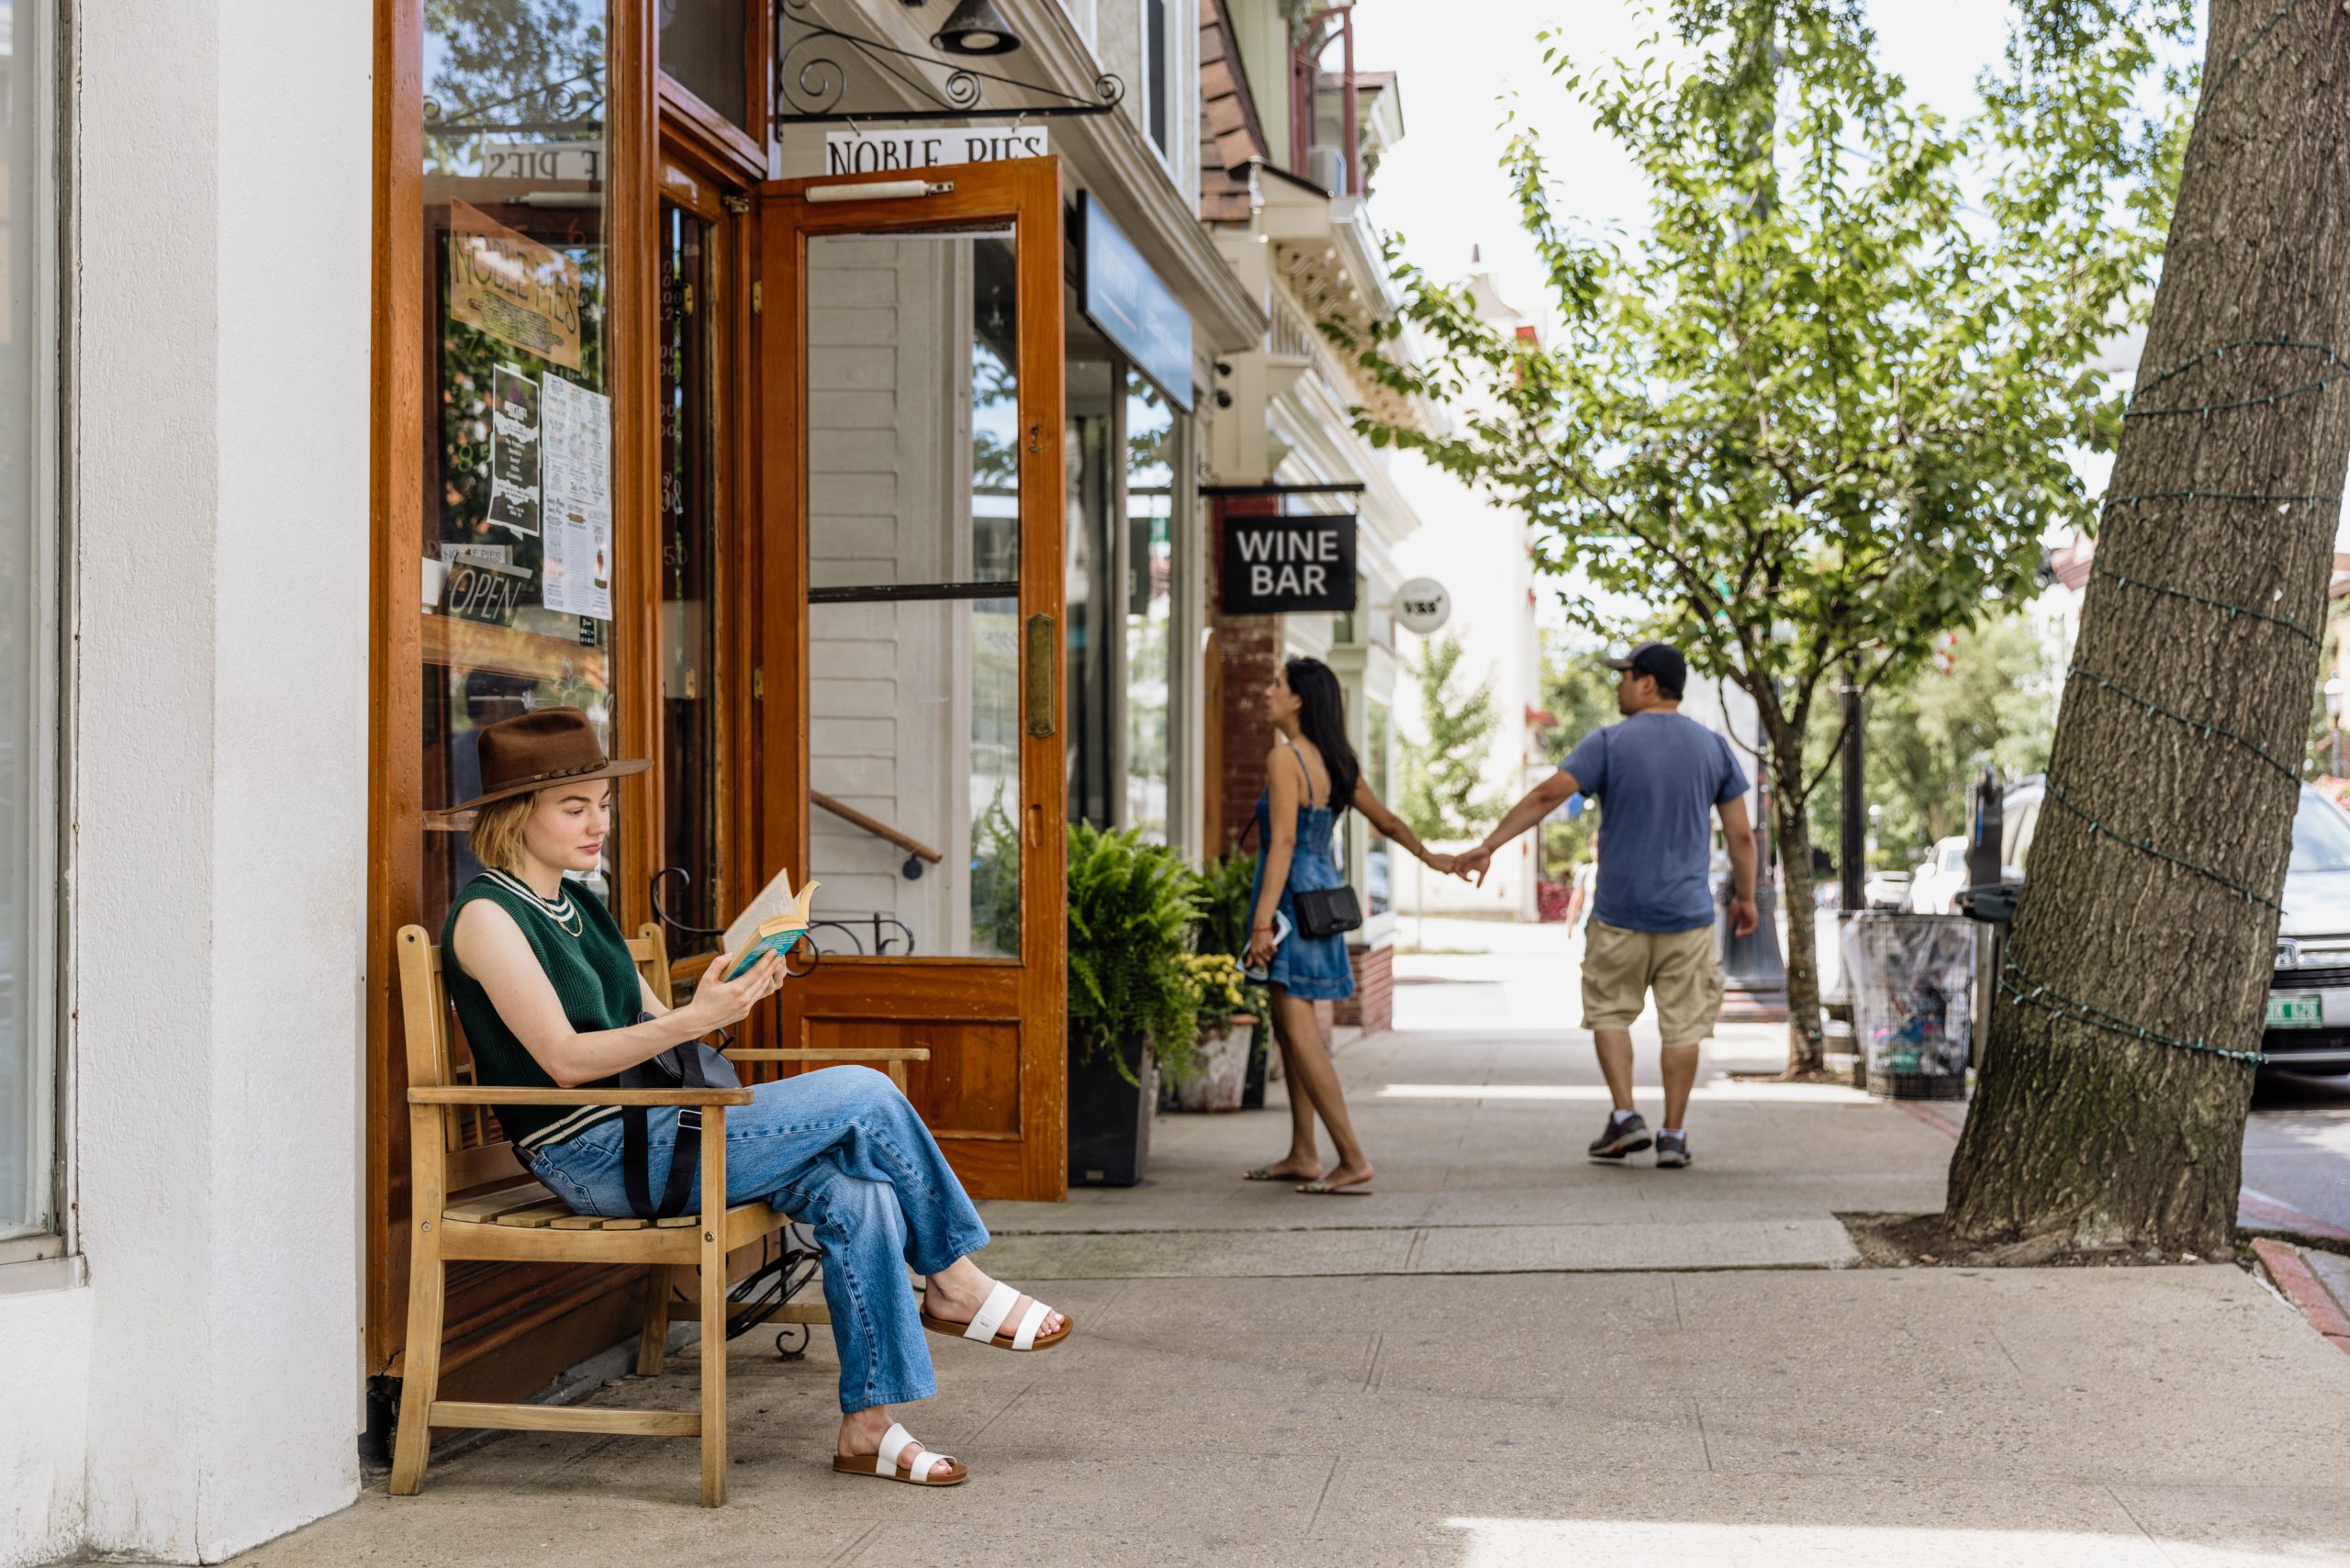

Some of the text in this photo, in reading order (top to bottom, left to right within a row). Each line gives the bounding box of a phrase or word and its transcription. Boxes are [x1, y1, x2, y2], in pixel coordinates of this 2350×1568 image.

[828, 137, 1042, 175] NOBLE PIES
[1237, 530, 1339, 562] WINE
[449, 568, 522, 622] OPEN
[1250, 564, 1328, 597] BAR
